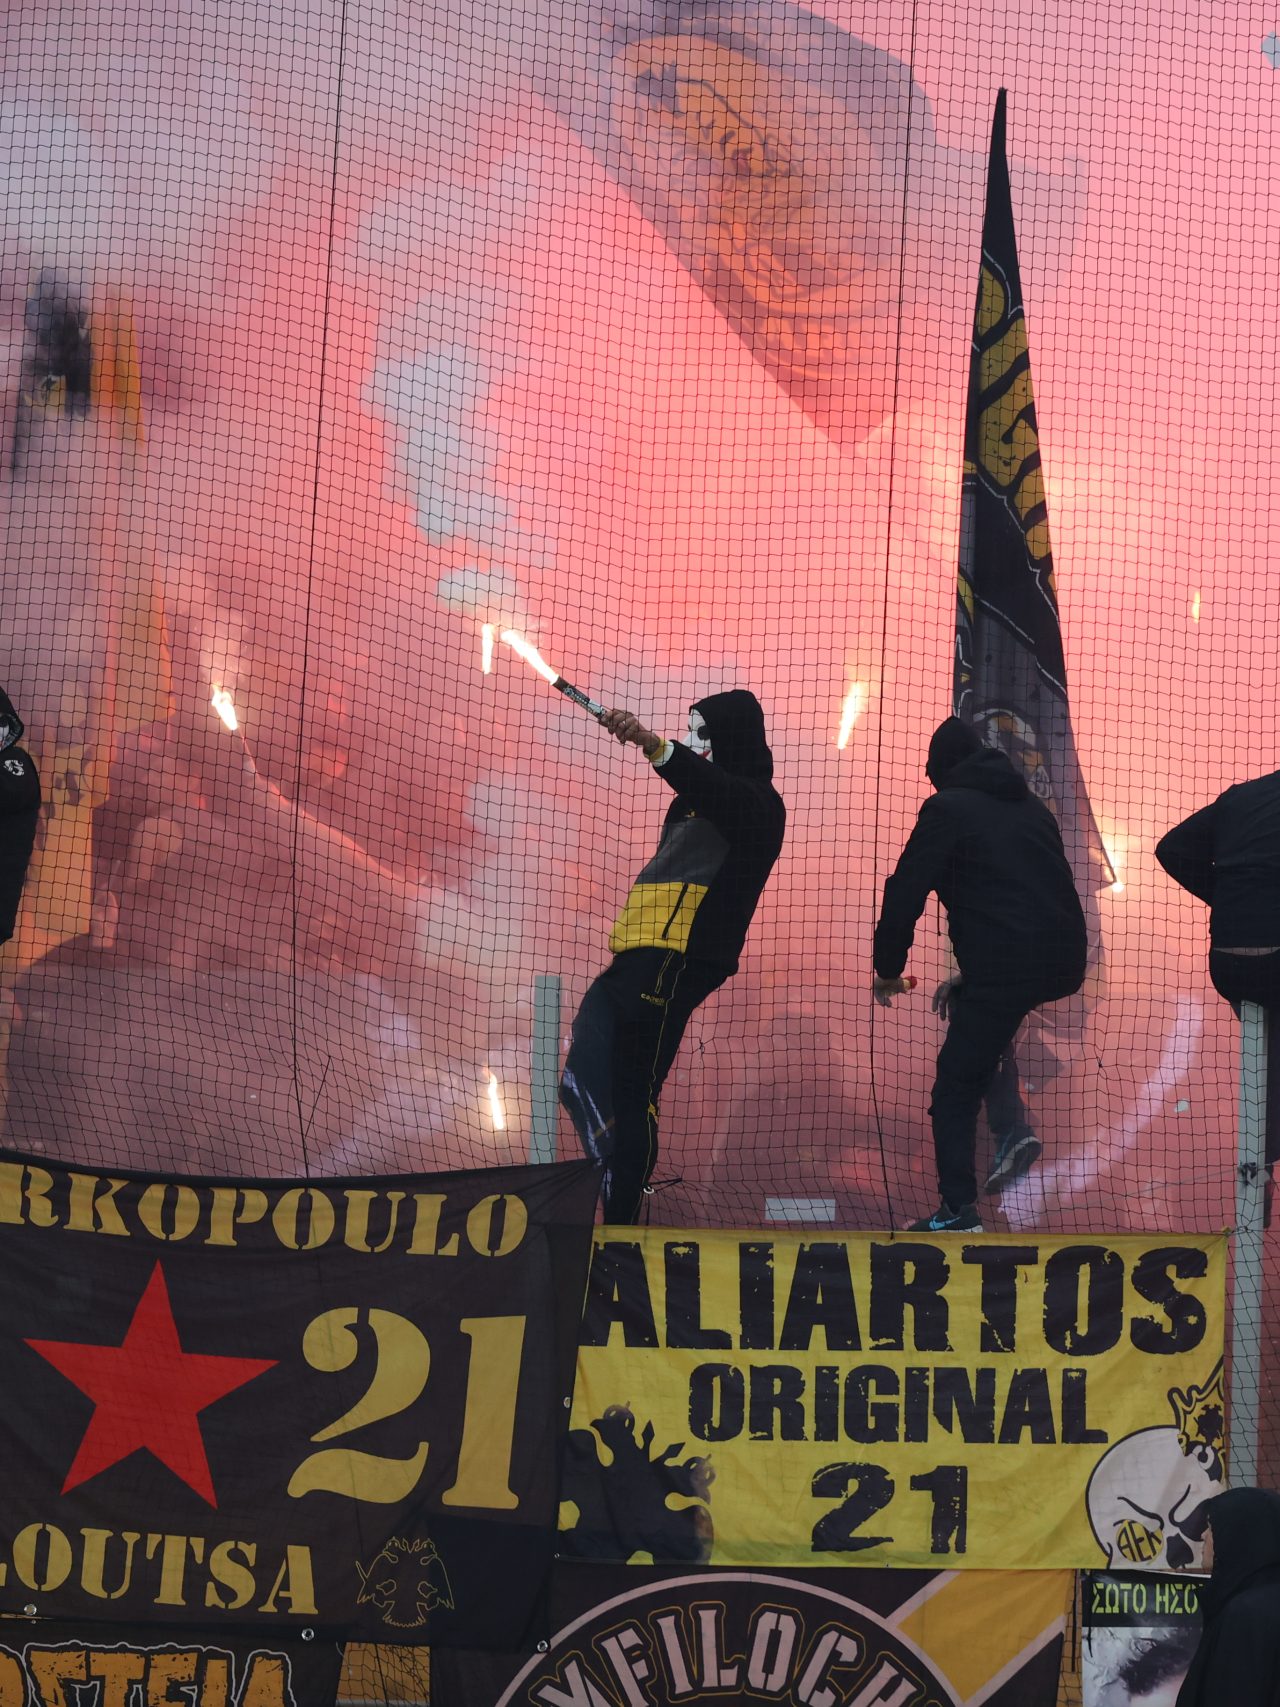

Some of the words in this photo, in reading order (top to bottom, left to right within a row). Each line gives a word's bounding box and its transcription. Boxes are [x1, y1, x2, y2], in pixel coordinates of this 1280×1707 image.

[578, 1240, 1209, 1357] ALIARTOS
[287, 1305, 528, 1510] 21
[687, 1362, 1109, 1446] ORIGINAL
[810, 1461, 971, 1555] 21
[0, 1521, 319, 1615] OUTSA
